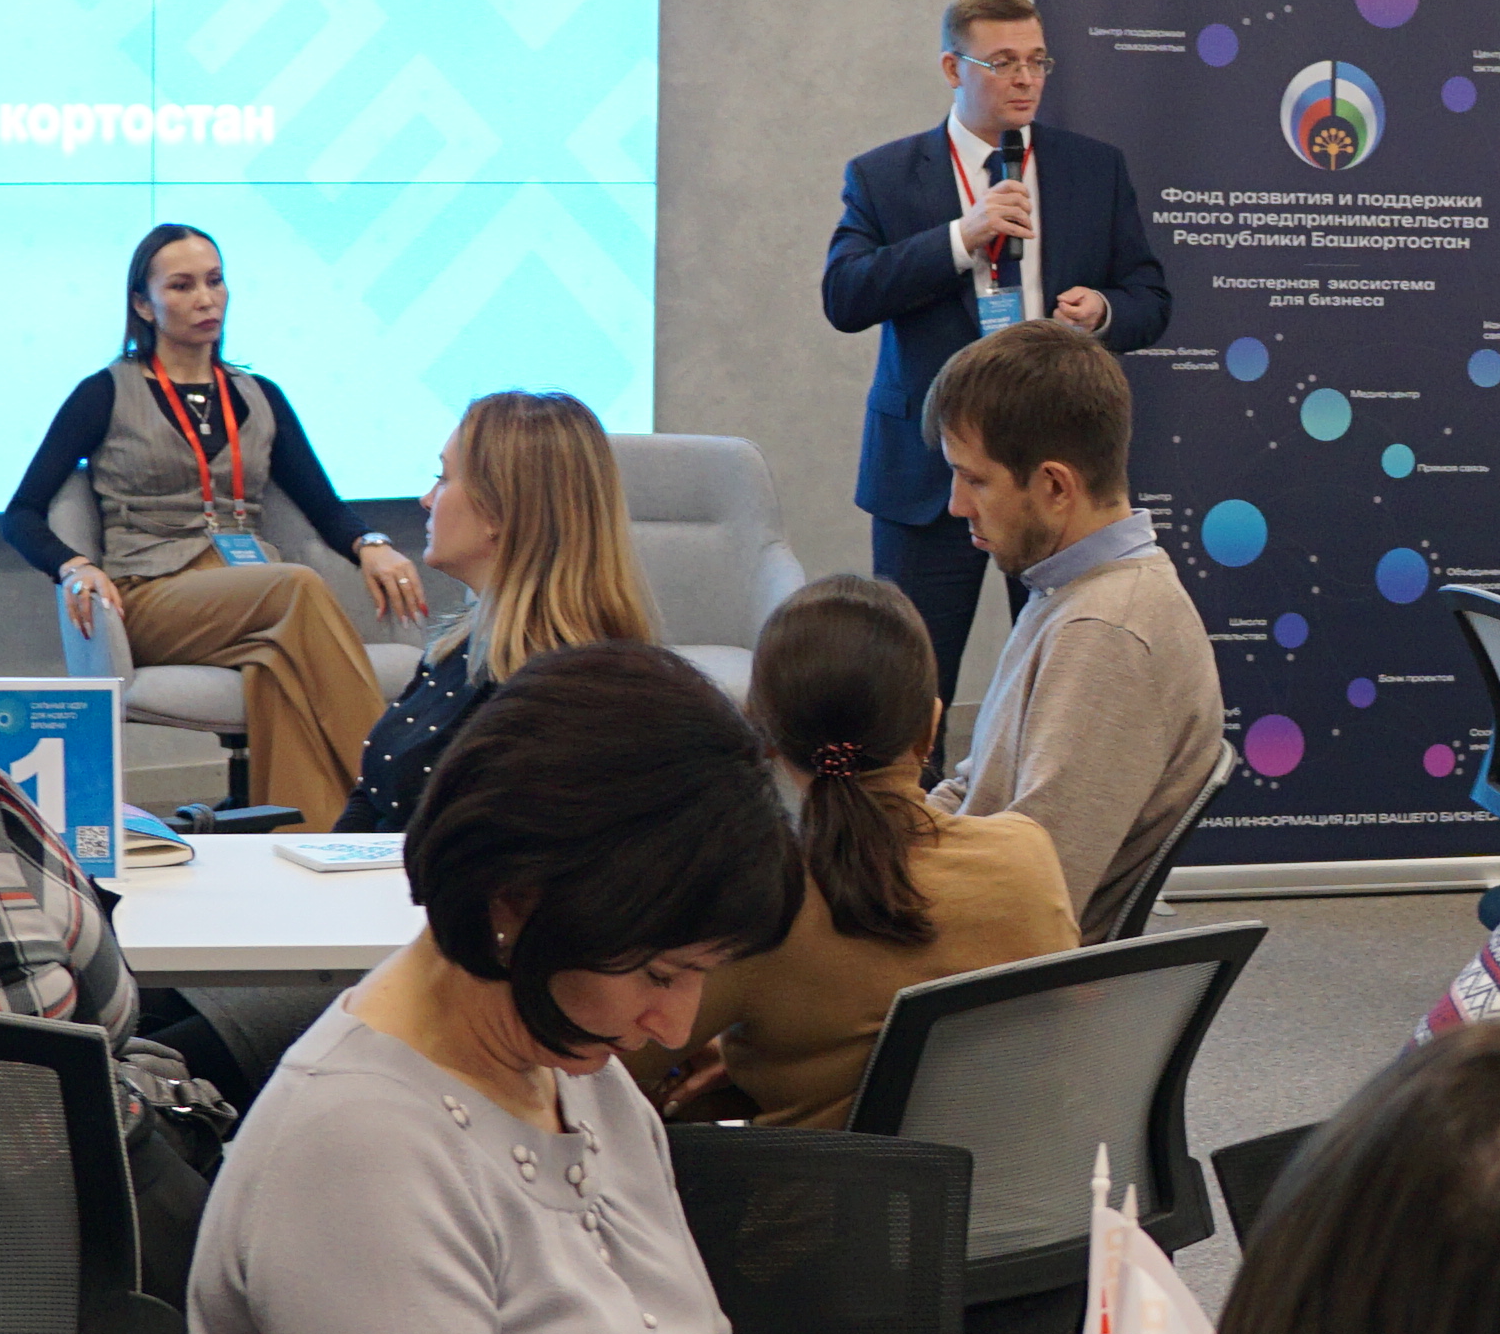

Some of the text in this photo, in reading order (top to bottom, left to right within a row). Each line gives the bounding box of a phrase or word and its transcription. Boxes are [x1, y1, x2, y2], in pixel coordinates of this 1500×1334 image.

[1161, 187, 1483, 210] Фонд развития и поддержки
[1152, 212, 1489, 231] малого предпринимательства
[1173, 230, 1471, 251] Республики Башкортостан
[1212, 275, 1436, 292] Кластерная экосистема
[1269, 293, 1385, 307] для бизнеса
[9, 737, 66, 834] 1
[1234, 812, 1438, 828] ИНФОРМАЦИЯ ДЛЯ ВАШЕГО
